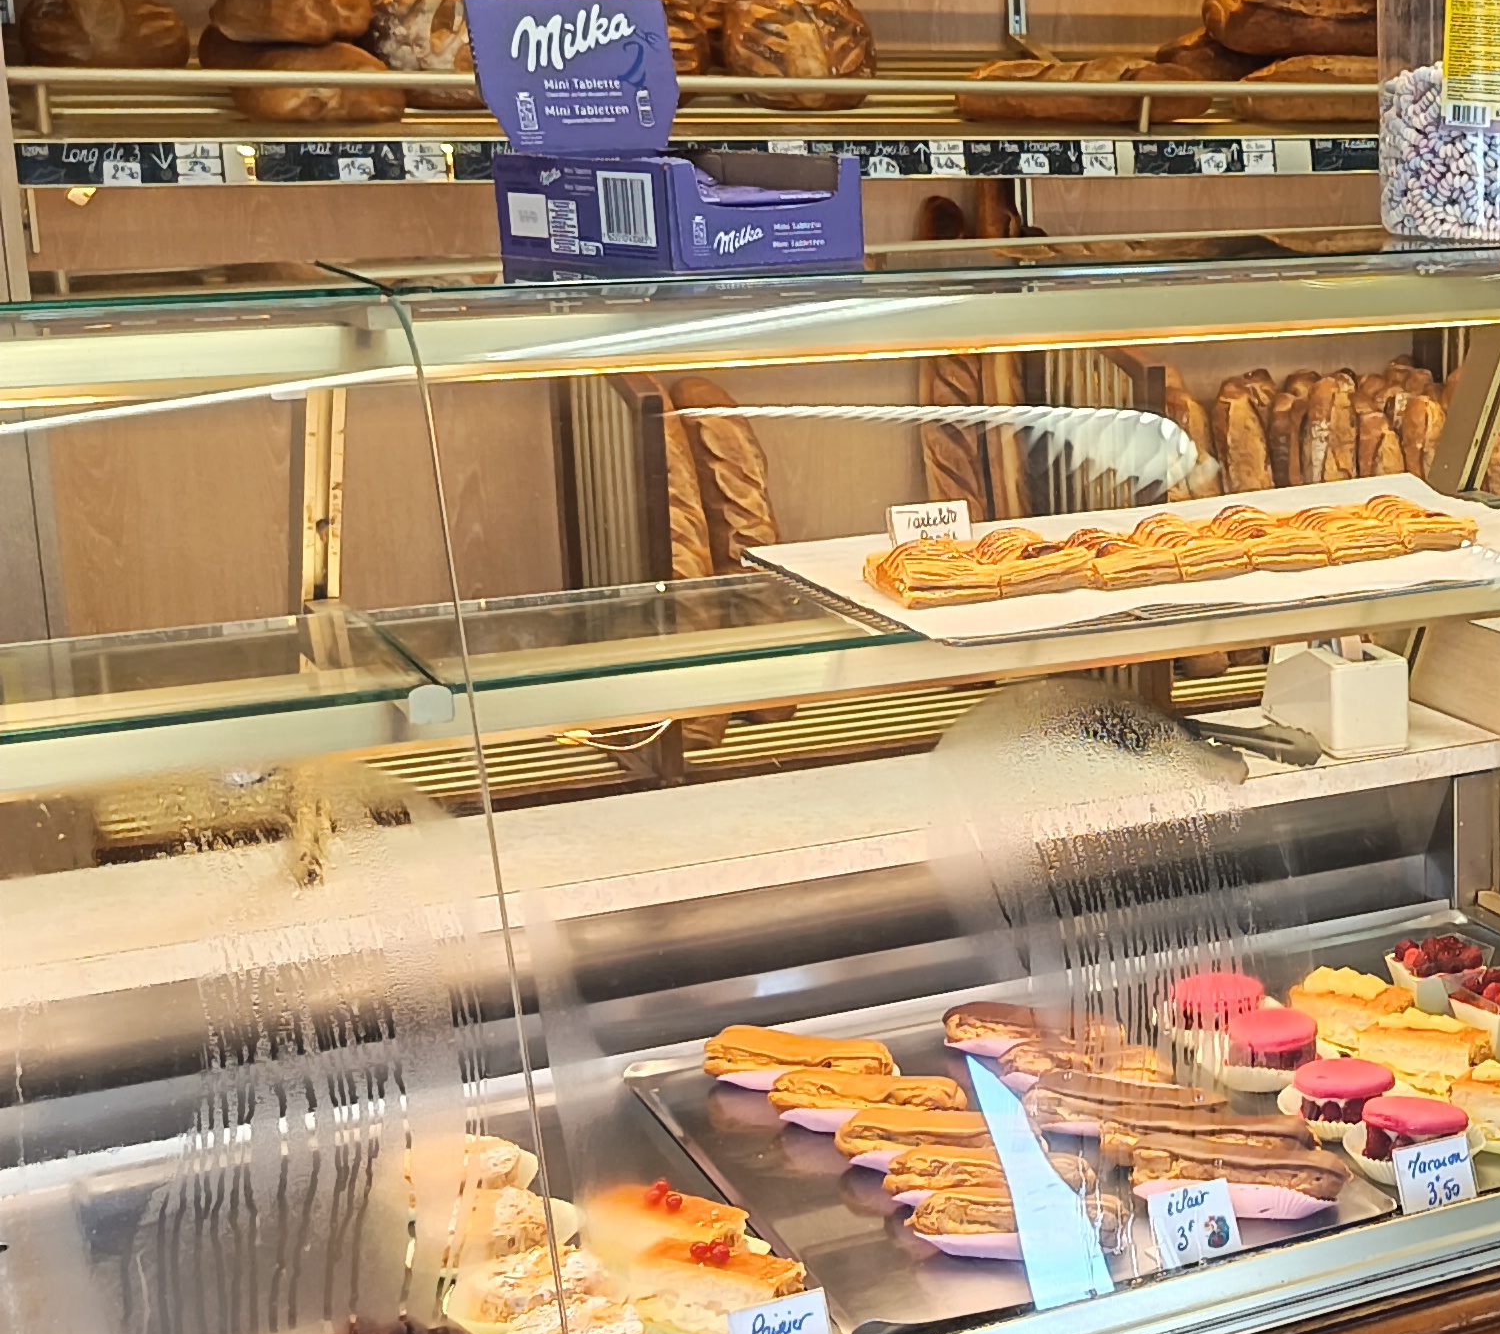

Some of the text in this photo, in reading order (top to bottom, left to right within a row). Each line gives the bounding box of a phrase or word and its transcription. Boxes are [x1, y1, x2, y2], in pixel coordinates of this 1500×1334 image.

[511, 3, 636, 72] Milka
[544, 78, 621, 90] Mini Tablette
[544, 104, 630, 116] Mini Tabletten
[62, 143, 99, 174] Long
[103, 143, 124, 161] de
[713, 224, 765, 255] Milka
